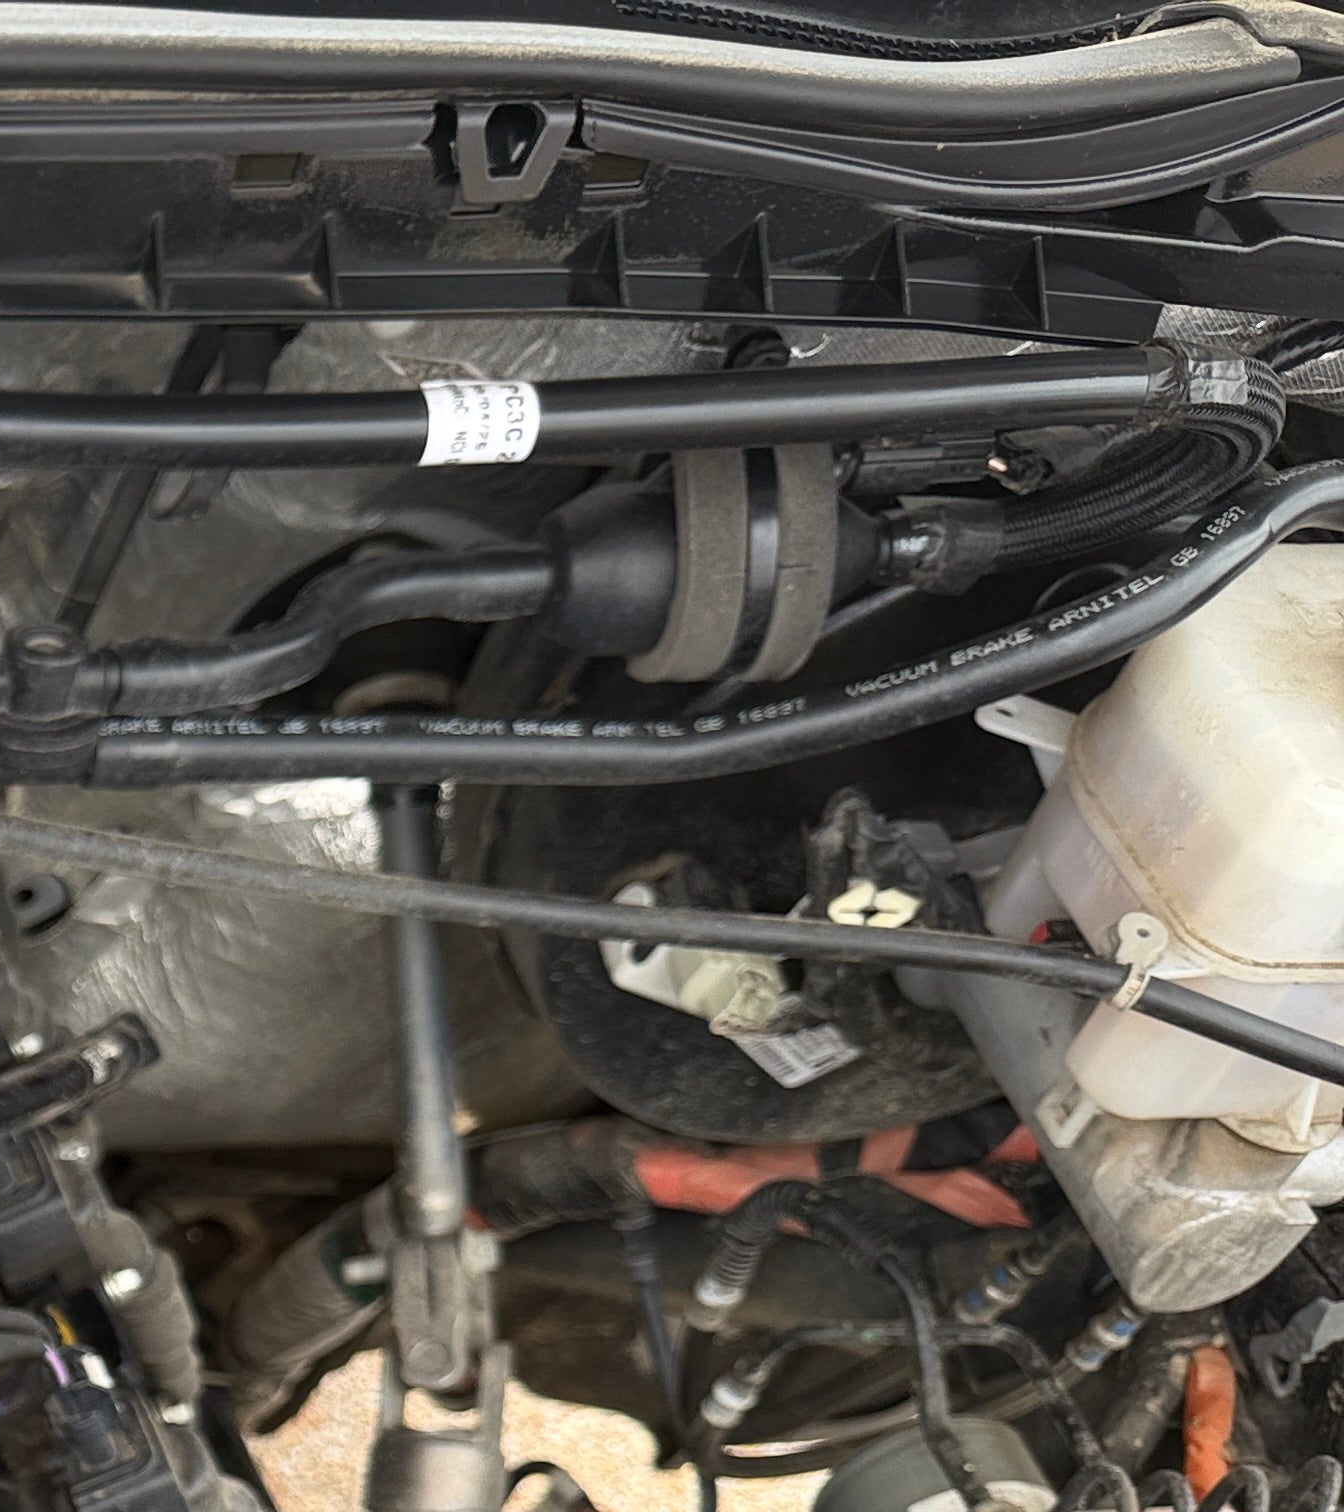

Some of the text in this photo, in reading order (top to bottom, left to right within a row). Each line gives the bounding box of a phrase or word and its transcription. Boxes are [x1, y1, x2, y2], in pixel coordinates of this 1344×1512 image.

[844, 660, 938, 698] VACUUM
[949, 626, 1035, 668] BRAKE
[1048, 573, 1165, 632] ARNITEL
